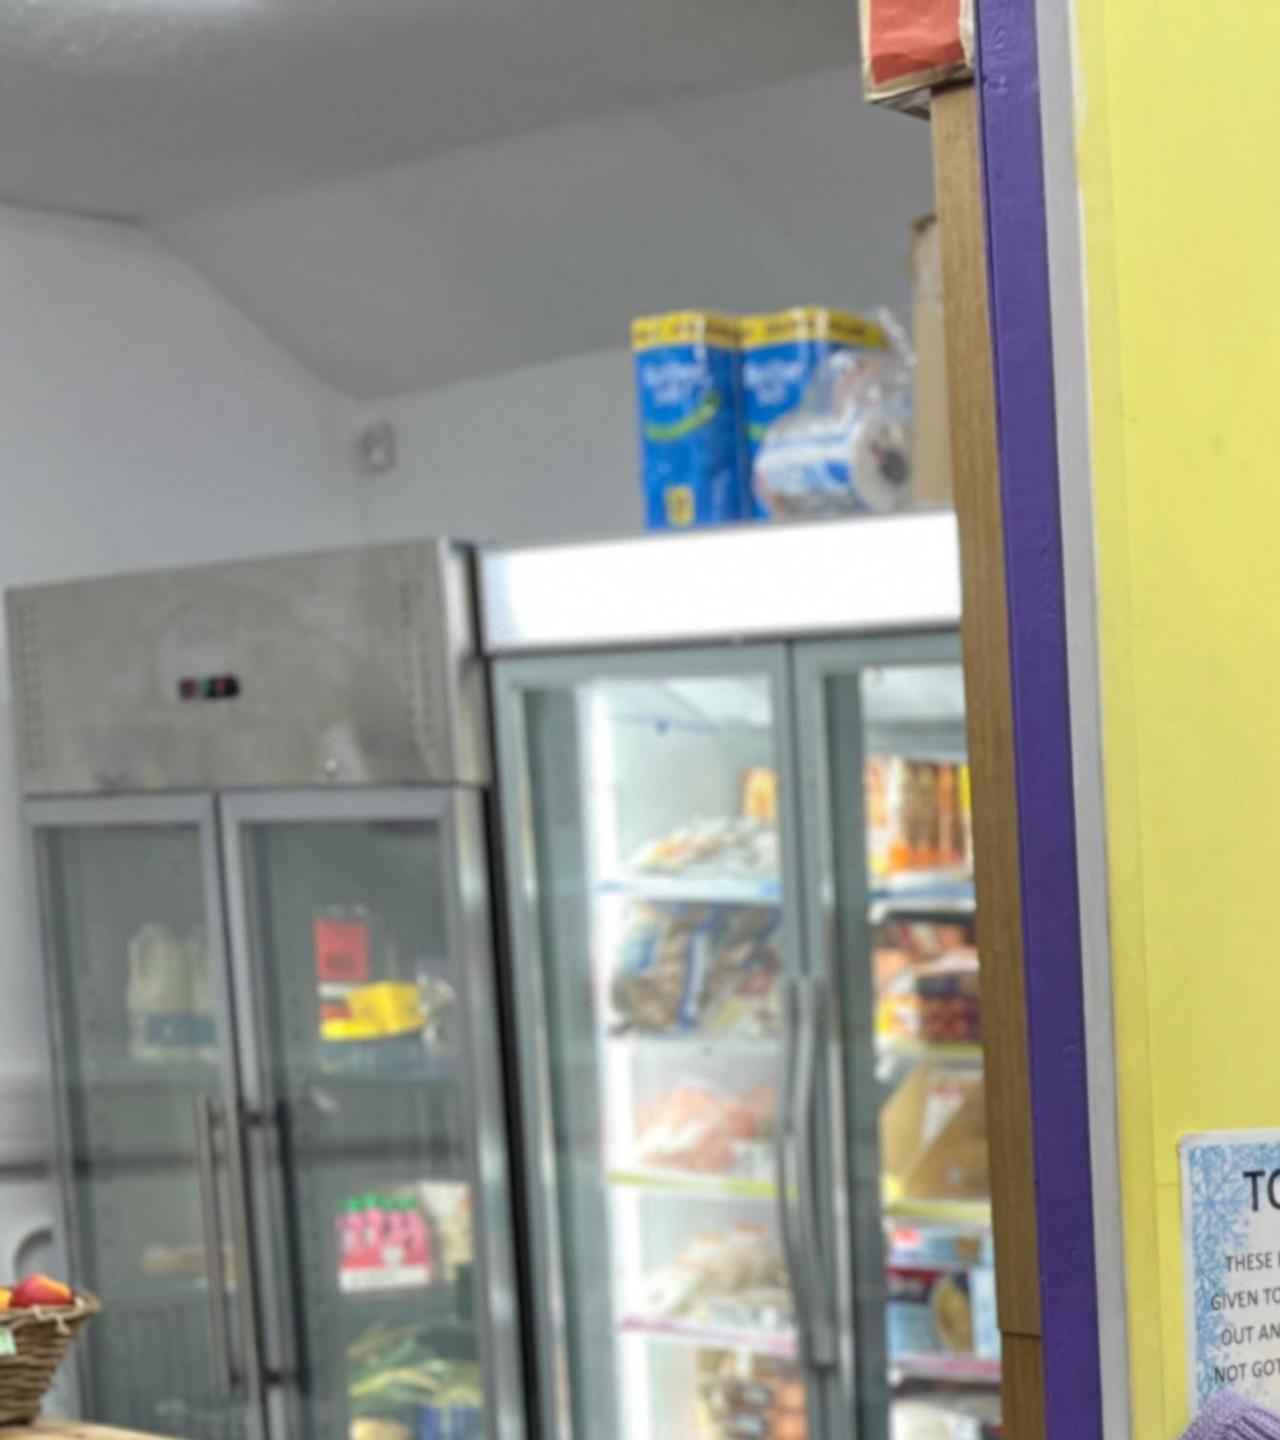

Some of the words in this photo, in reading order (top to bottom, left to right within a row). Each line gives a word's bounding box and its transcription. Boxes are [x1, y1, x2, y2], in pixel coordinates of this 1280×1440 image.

[1225, 1252, 1273, 1272] THESE
[1210, 1289, 1258, 1311] GIVEN
[1220, 1325, 1255, 1347] OUT
[1214, 1363, 1247, 1383] NOT
